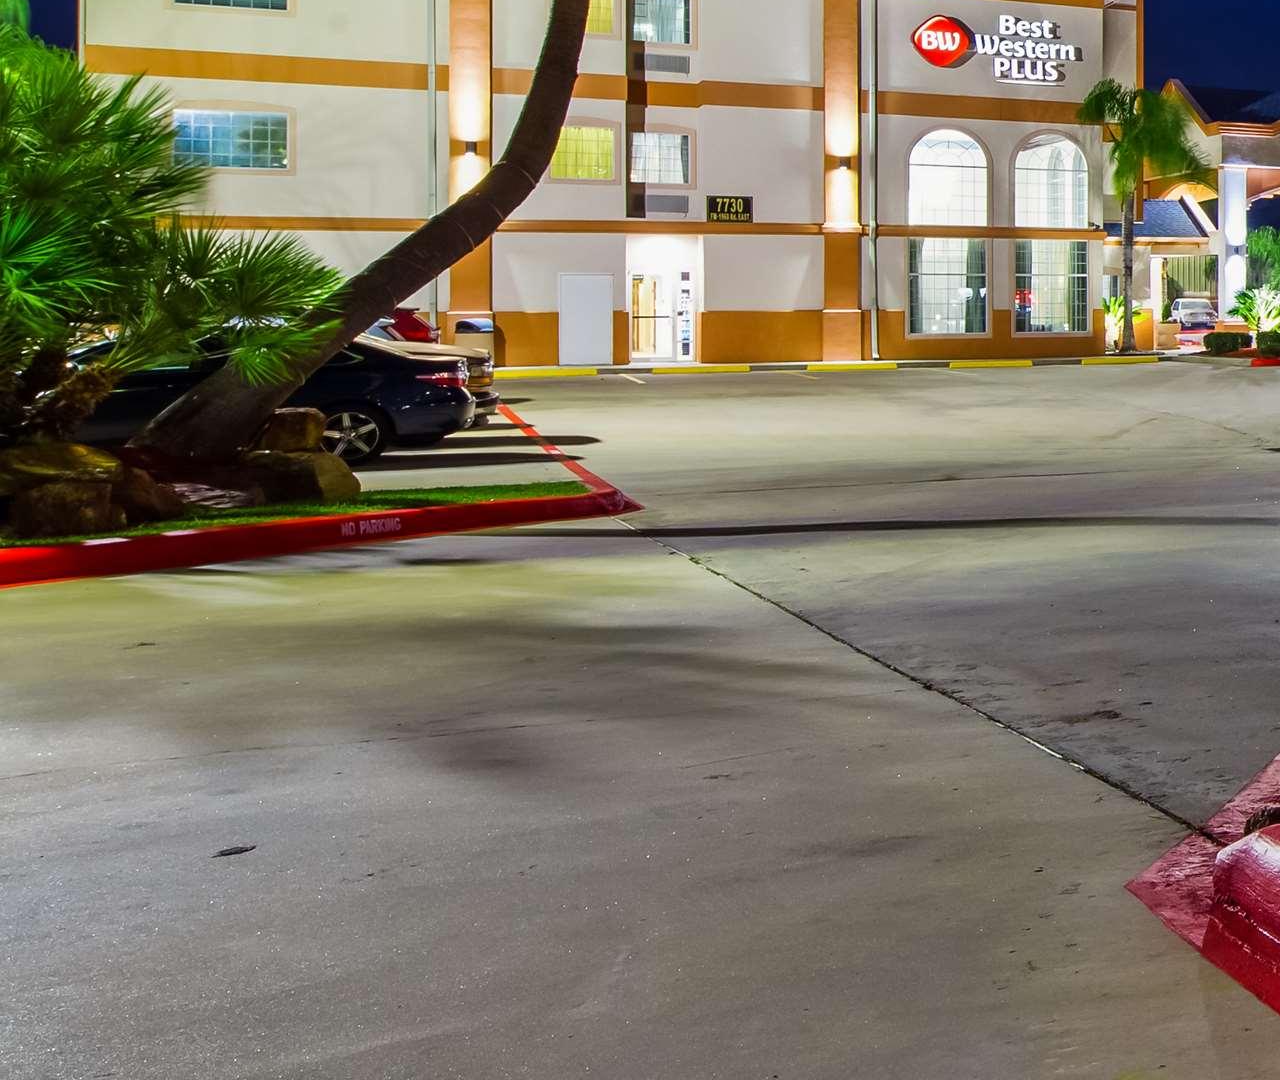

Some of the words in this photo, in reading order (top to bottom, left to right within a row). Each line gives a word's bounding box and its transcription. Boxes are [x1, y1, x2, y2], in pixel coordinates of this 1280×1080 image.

[998, 15, 1054, 38] Best
[920, 31, 960, 51] BW
[975, 34, 1076, 61] Western
[994, 58, 1059, 81] PLUS
[716, 198, 743, 212] 7730
[341, 521, 356, 537] NO
[360, 517, 401, 536] PARKING
